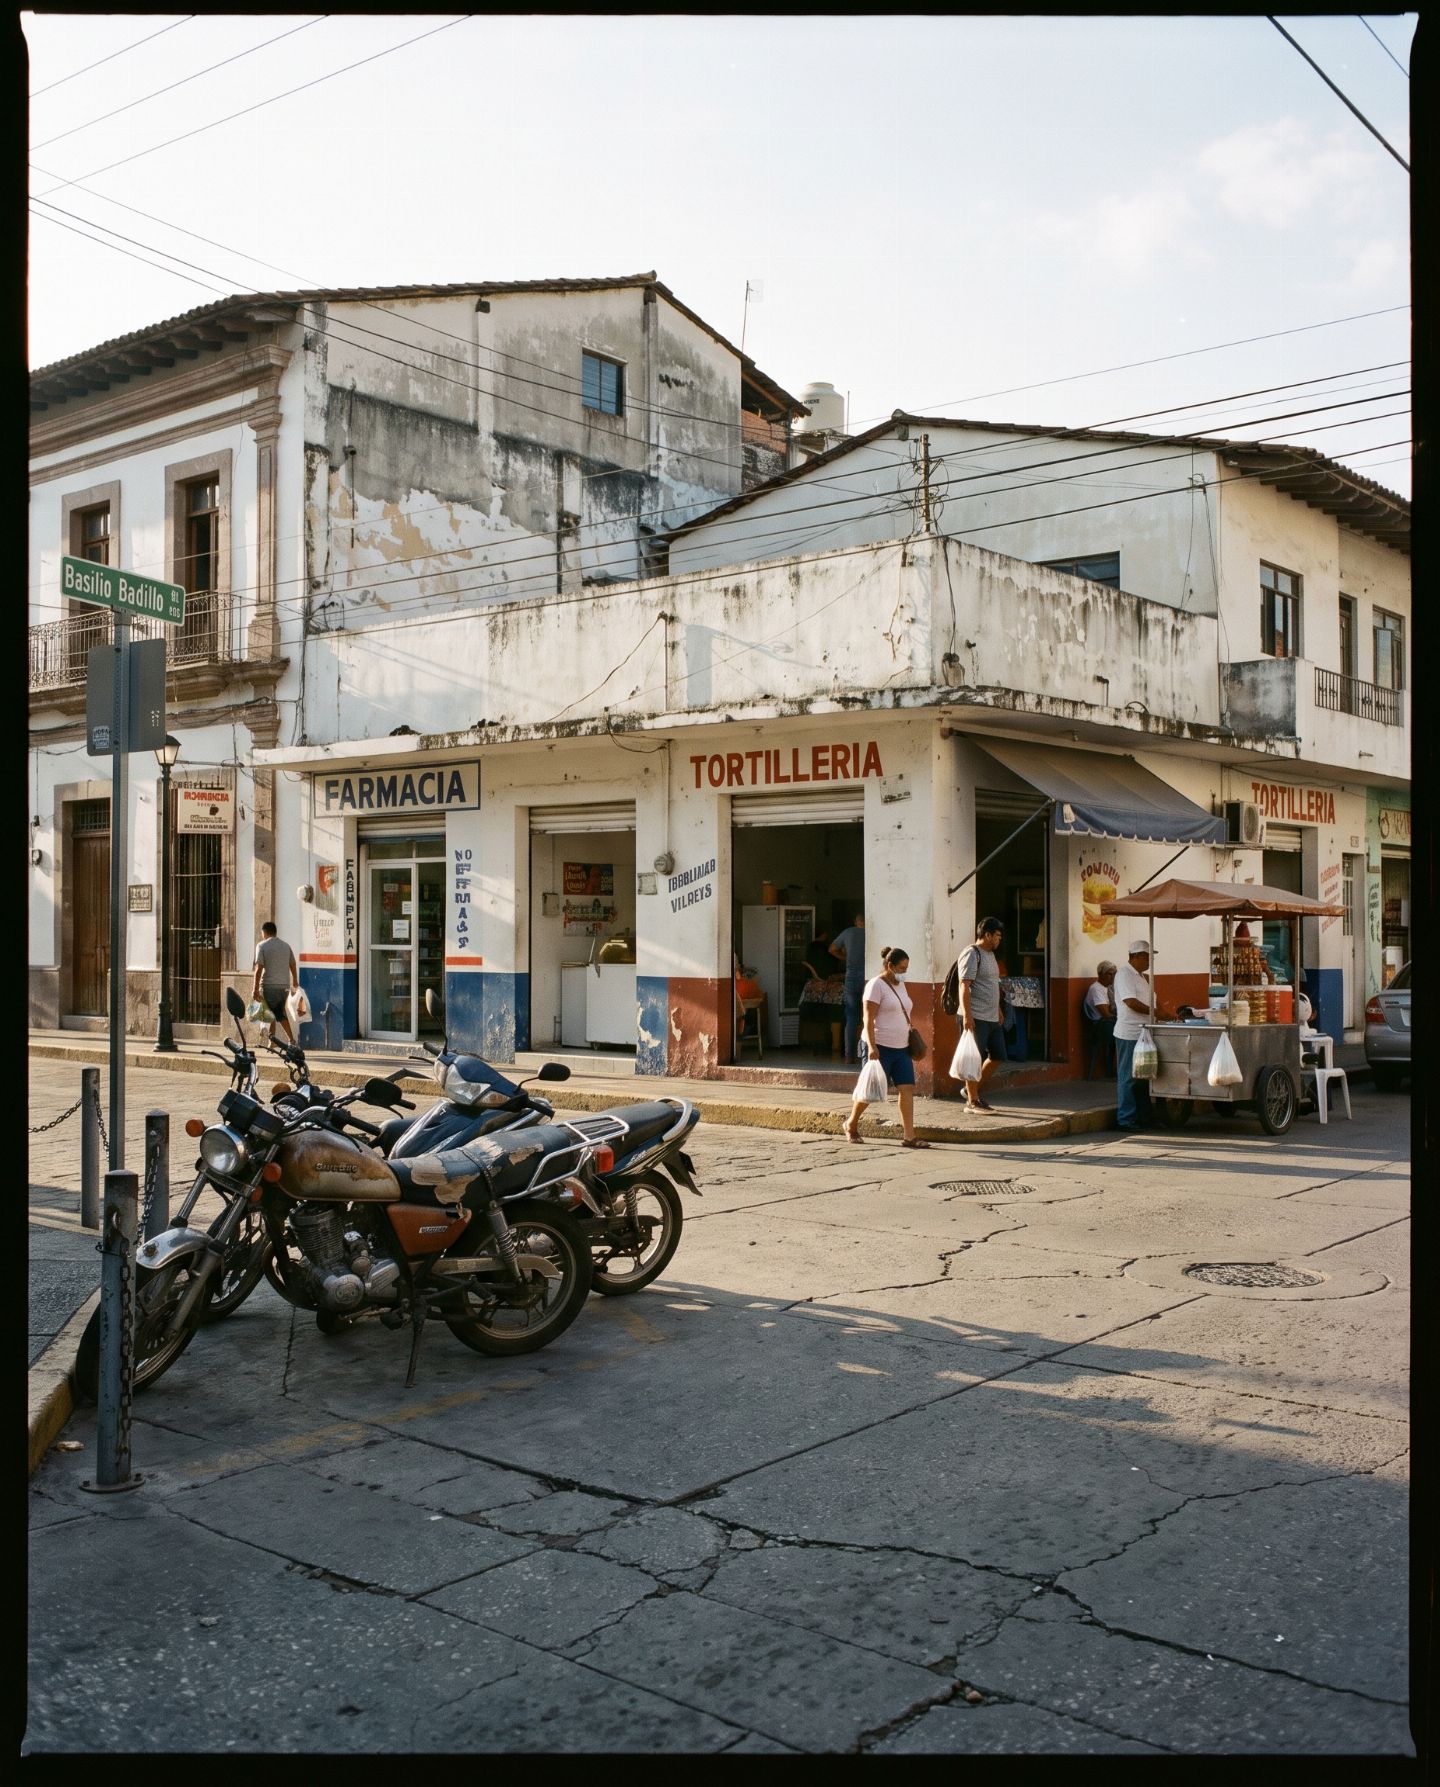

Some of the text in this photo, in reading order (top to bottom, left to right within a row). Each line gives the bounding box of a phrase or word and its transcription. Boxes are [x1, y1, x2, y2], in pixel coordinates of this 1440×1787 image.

[65, 563, 164, 612] Basilio Badillo
[690, 741, 883, 789] TORTILLERIA
[325, 770, 466, 811] FARMACIA
[1251, 782, 1336, 825] TORTILLERIA
